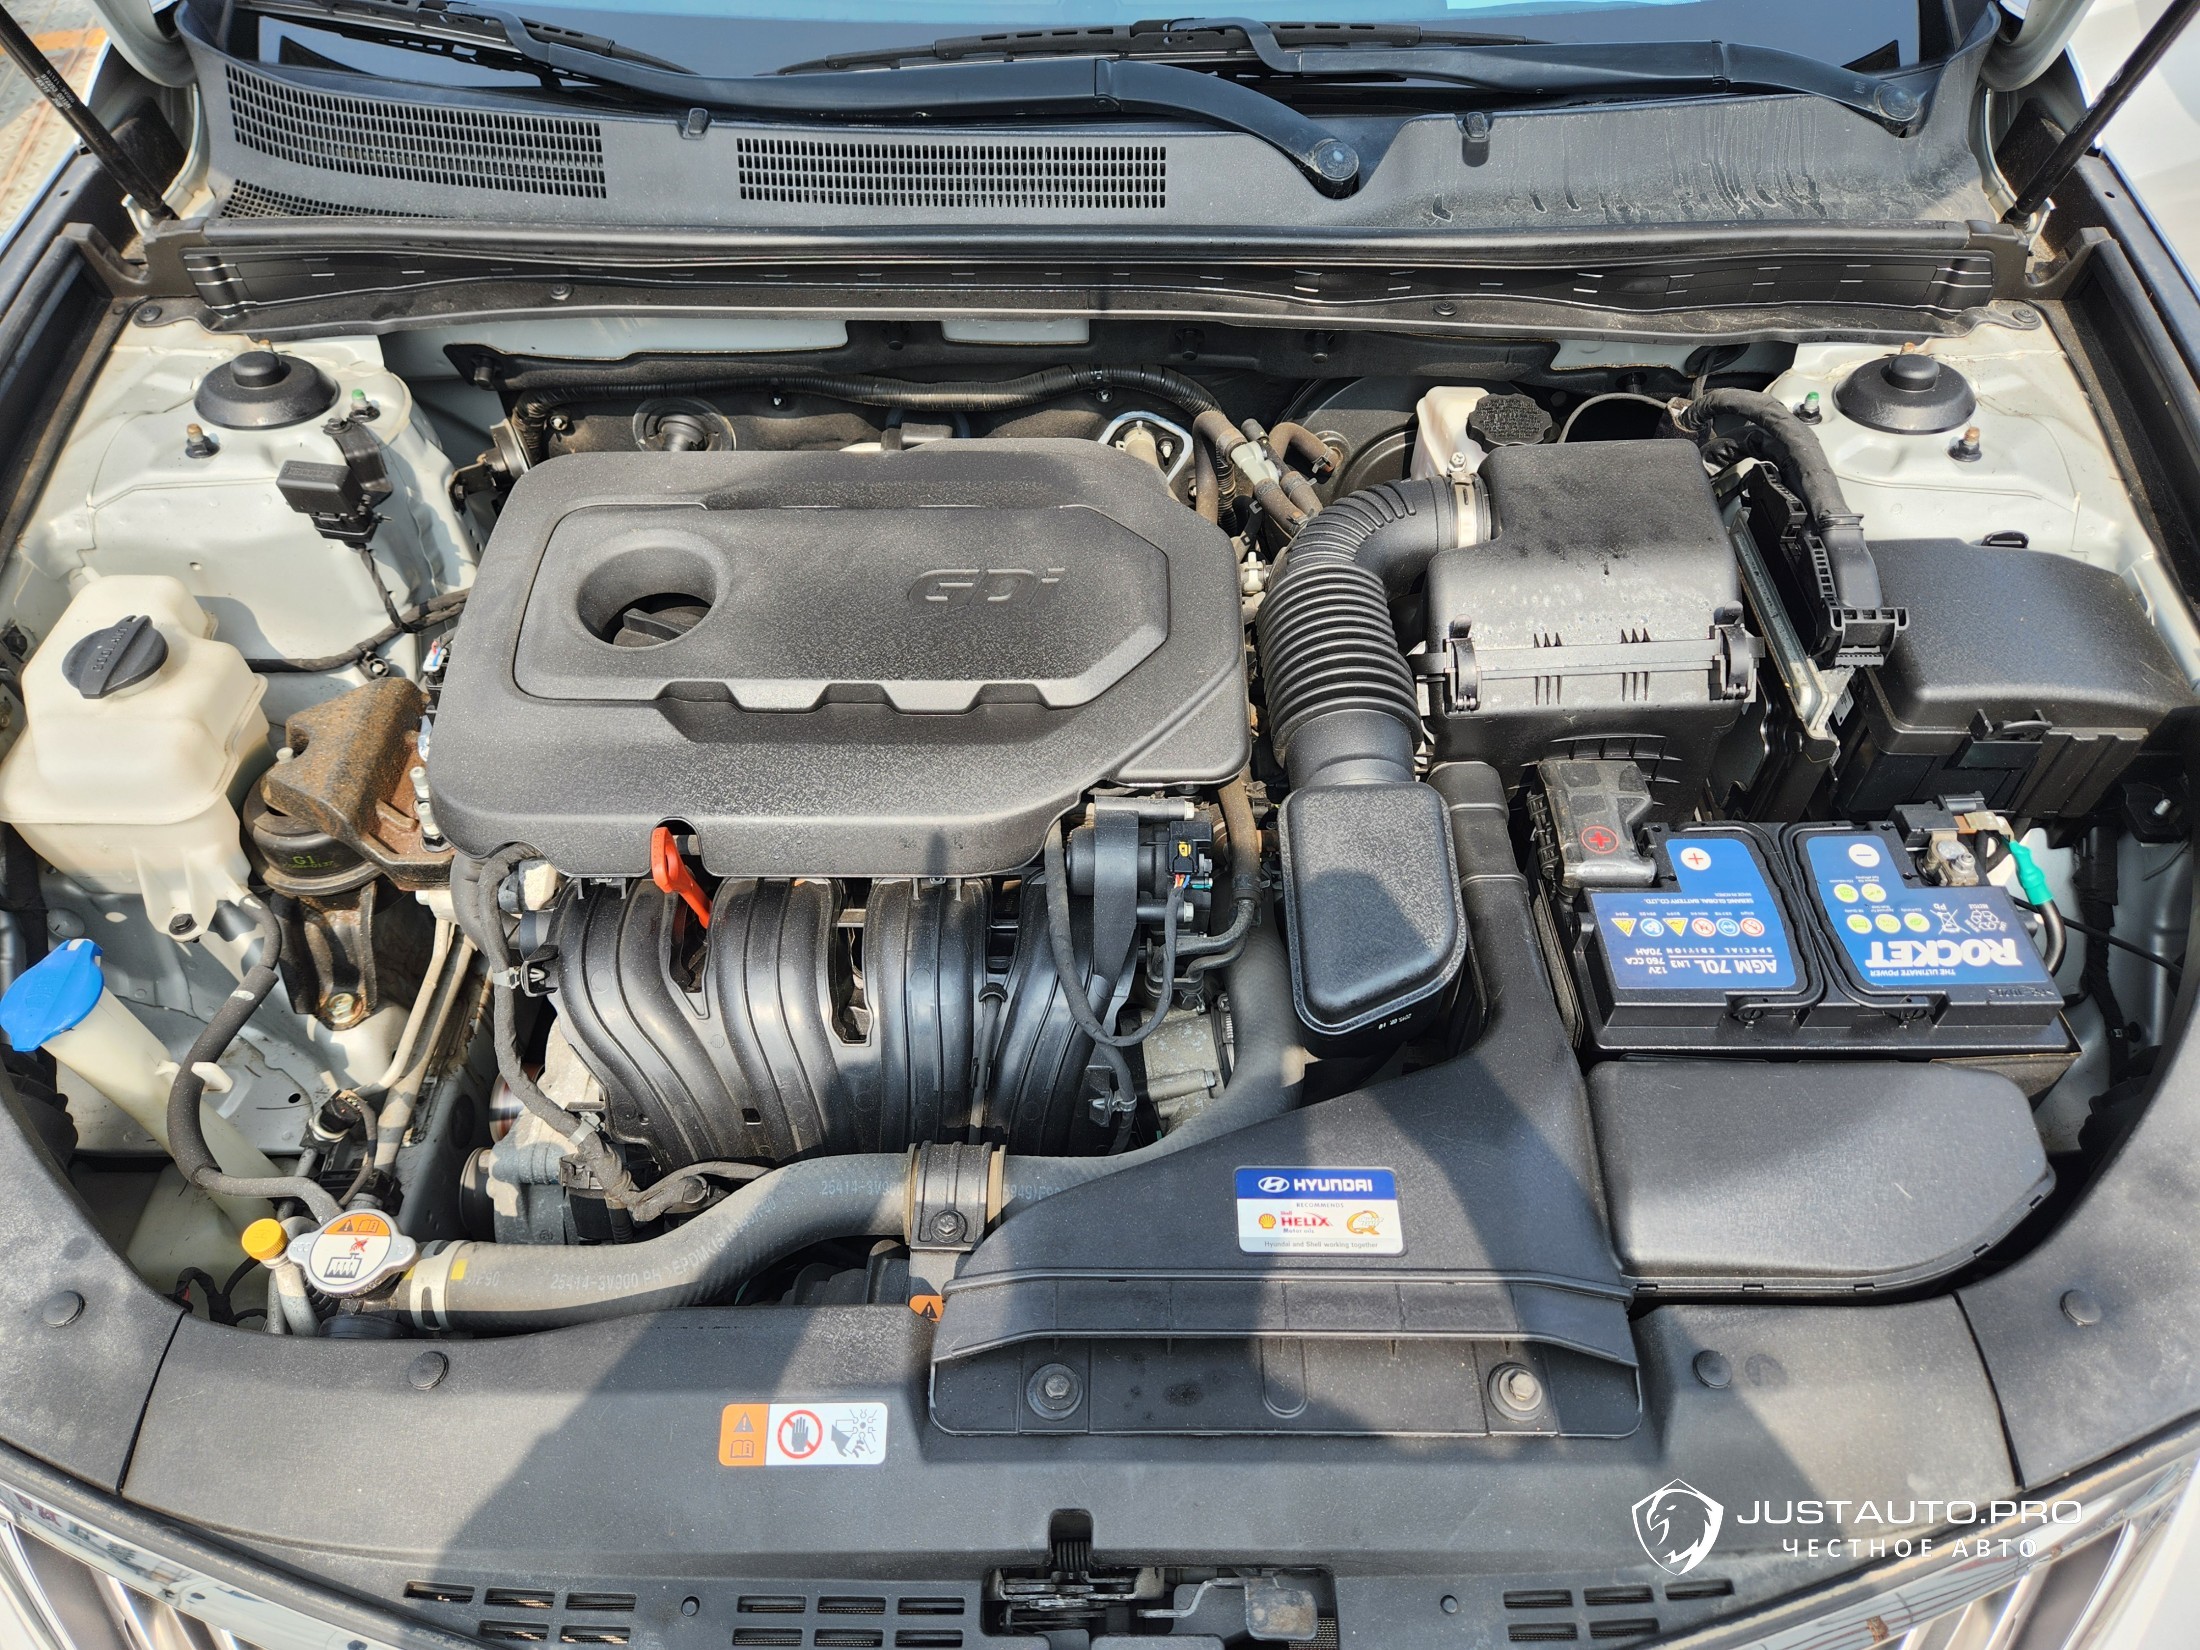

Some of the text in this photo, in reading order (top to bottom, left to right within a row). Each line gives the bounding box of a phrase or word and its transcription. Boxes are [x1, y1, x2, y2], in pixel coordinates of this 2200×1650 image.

[1933, 902, 1947, 911] Pb
[1865, 938, 2023, 968] ROCKET
[1624, 957, 1645, 965] CCA
[1648, 965, 1668, 974] 12V
[1671, 959, 1777, 974] AGM 70L LN3
[1870, 969, 1899, 977] POWER
[1940, 969, 1956, 977] THE
[1293, 1178, 1374, 1192] HYUNDAI
[1280, 1216, 1331, 1227] HELIX
[1264, 1241, 1291, 1249] Hyundai
[1323, 1241, 1350, 1249] working
[1351, 1241, 1378, 1249] together
